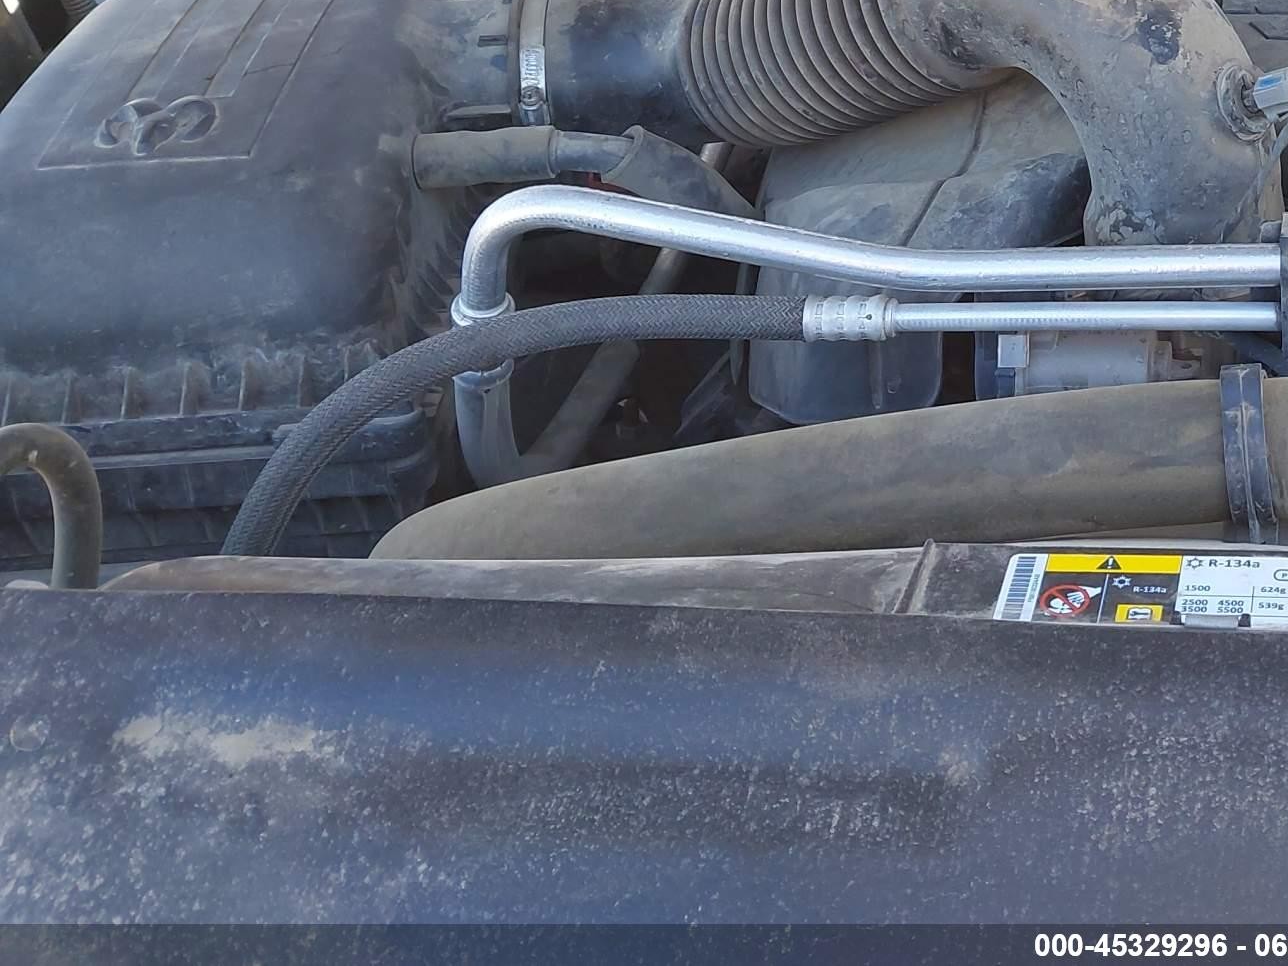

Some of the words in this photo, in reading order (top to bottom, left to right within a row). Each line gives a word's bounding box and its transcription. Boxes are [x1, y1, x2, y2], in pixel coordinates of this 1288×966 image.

[1208, 558, 1261, 569] R-134a
[1132, 586, 1168, 594] R-134a
[1184, 584, 1212, 592] 1500
[1260, 586, 1287, 595] 624g
[1181, 598, 1209, 606] 2500
[1217, 599, 1245, 607] 4500
[1257, 602, 1285, 611] 539g
[1181, 605, 1208, 613] 3500
[1216, 606, 1244, 614] 5500
